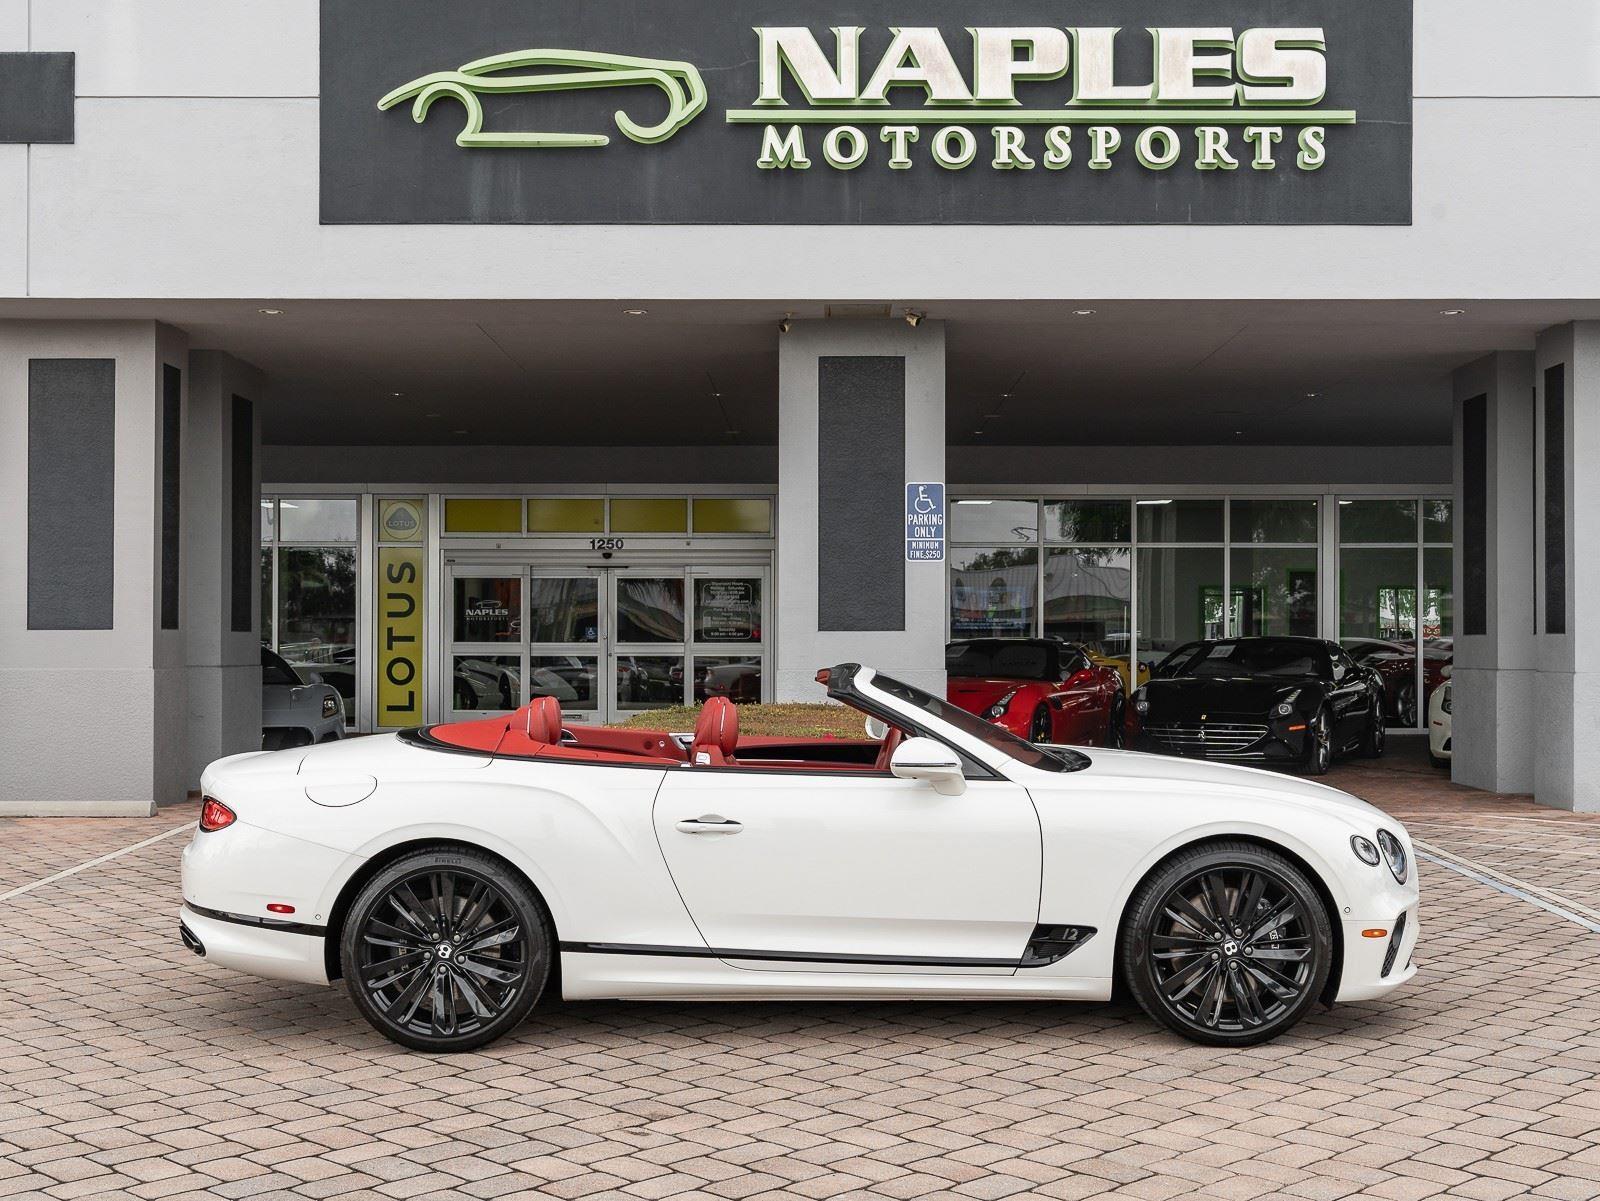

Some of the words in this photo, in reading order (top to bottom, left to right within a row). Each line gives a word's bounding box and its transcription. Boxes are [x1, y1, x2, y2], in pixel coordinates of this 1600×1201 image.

[752, 26, 1327, 106] NAPLES
[756, 124, 1327, 171] MOTORSPORTS
[907, 513, 943, 525] PARKING
[914, 526, 937, 538] ONLY
[589, 538, 624, 550] 1250
[911, 541, 939, 549] MINIMUM
[465, 608, 509, 616] NAPLES
[386, 561, 416, 712] LOTUS
[1062, 927, 1079, 940] 12
